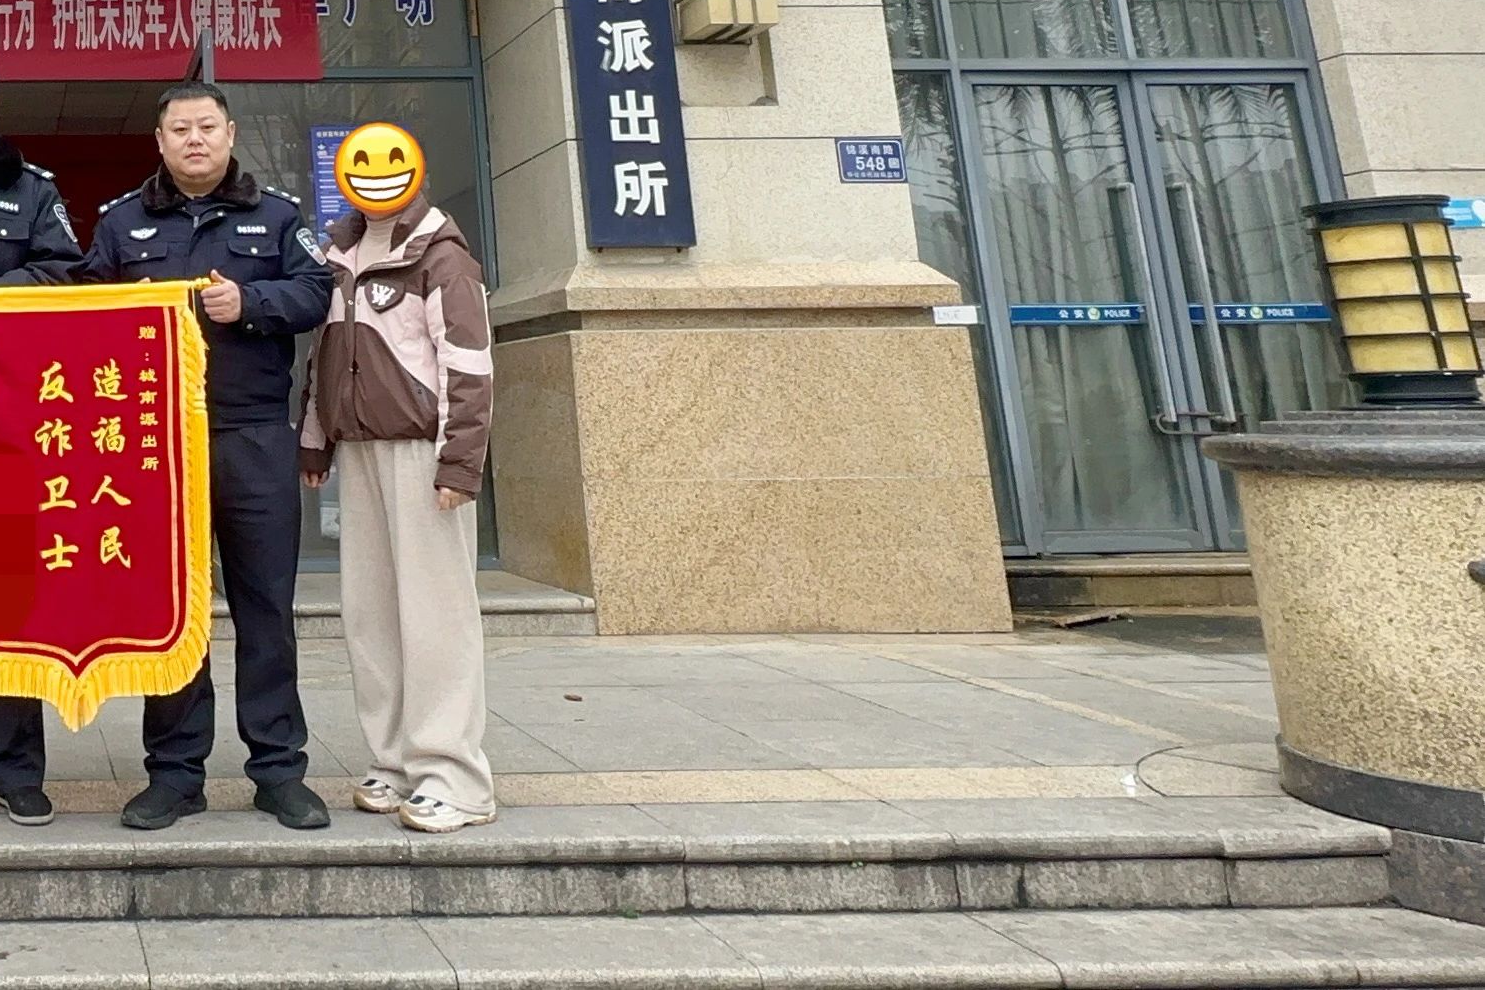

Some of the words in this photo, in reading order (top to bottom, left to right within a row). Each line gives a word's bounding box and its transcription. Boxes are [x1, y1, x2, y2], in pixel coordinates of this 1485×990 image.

[855, 156, 885, 170] 548
[35, 360, 80, 571] 反诈卫士
[90, 358, 132, 569] 造福人民
